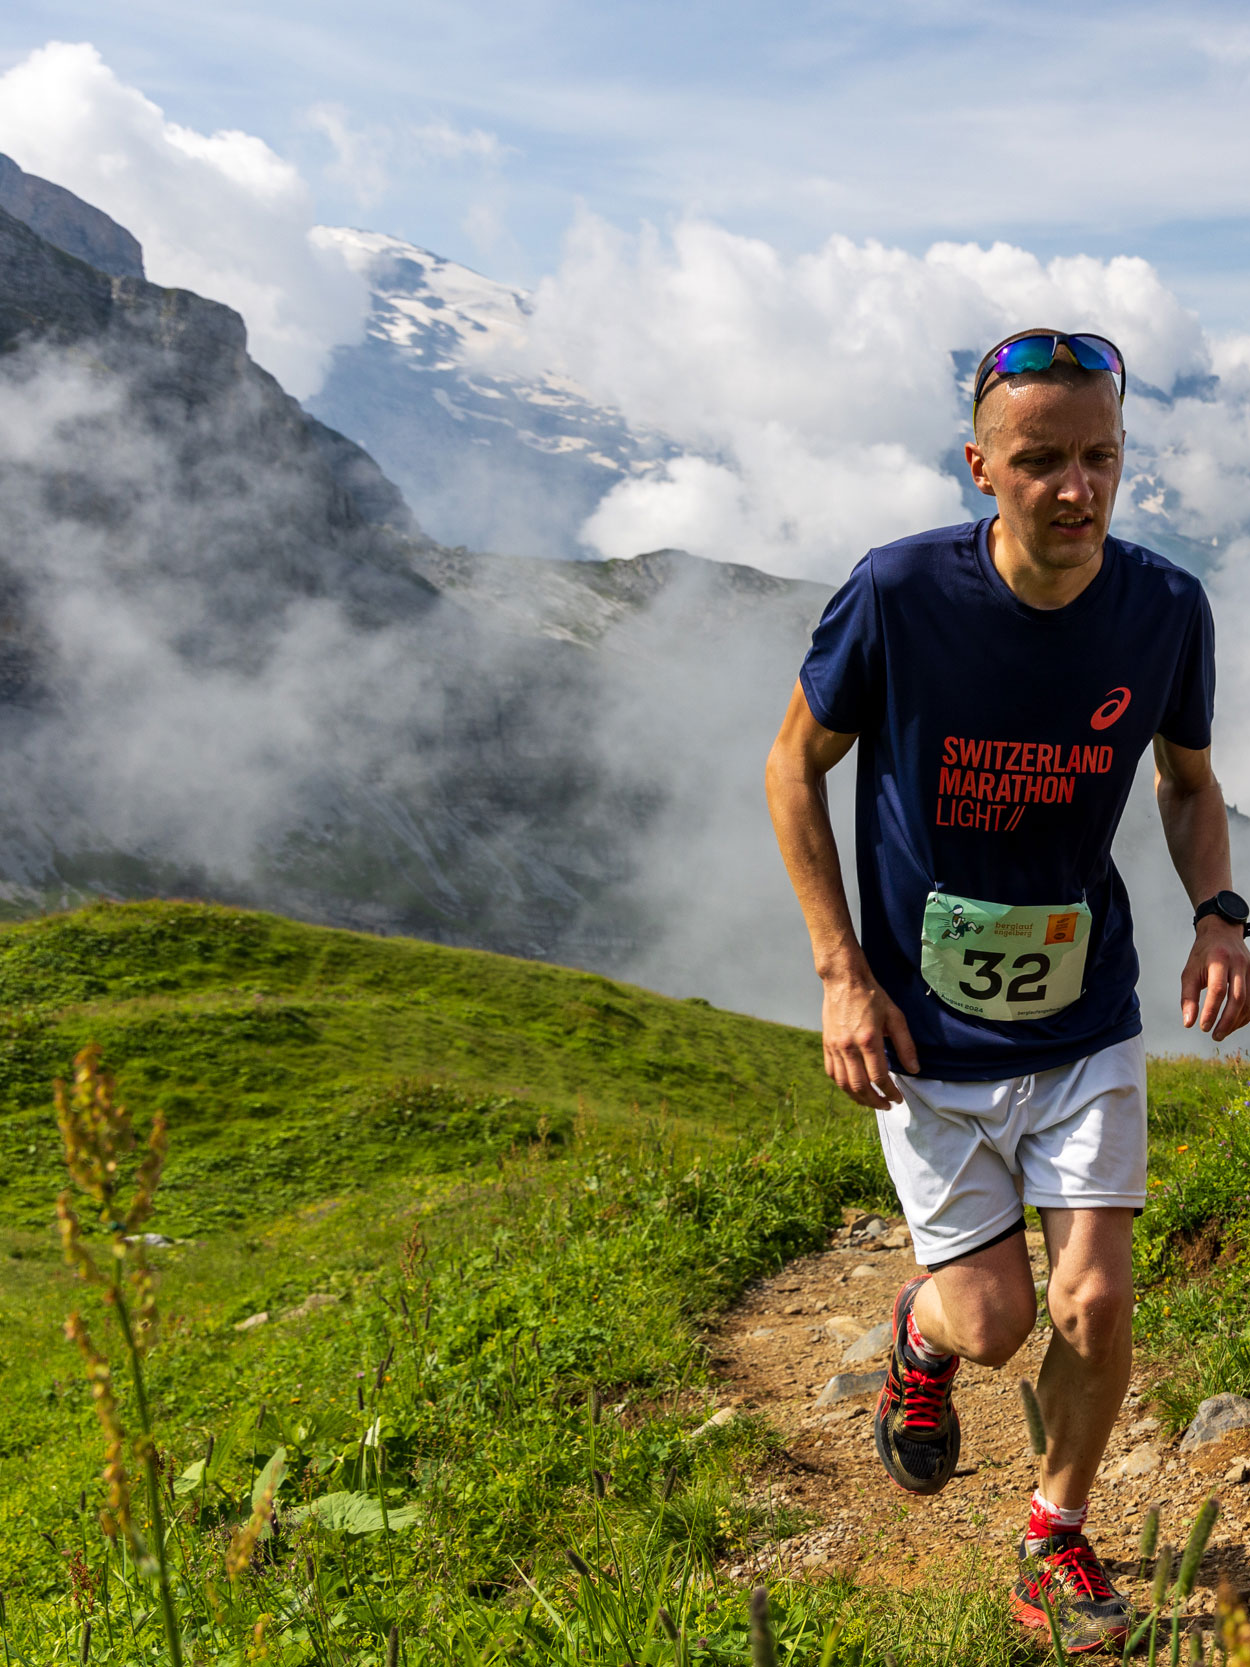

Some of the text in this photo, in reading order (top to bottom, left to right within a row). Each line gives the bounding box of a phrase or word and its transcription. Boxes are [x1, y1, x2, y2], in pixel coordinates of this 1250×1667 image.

[941, 736, 1114, 774] SWITZERLAND
[938, 767, 1076, 804] MARATHON
[994, 921, 1034, 931] berglauf
[994, 929, 1032, 938] engelberg
[959, 948, 1051, 1003] 32
[964, 1004, 984, 1013] 2024
